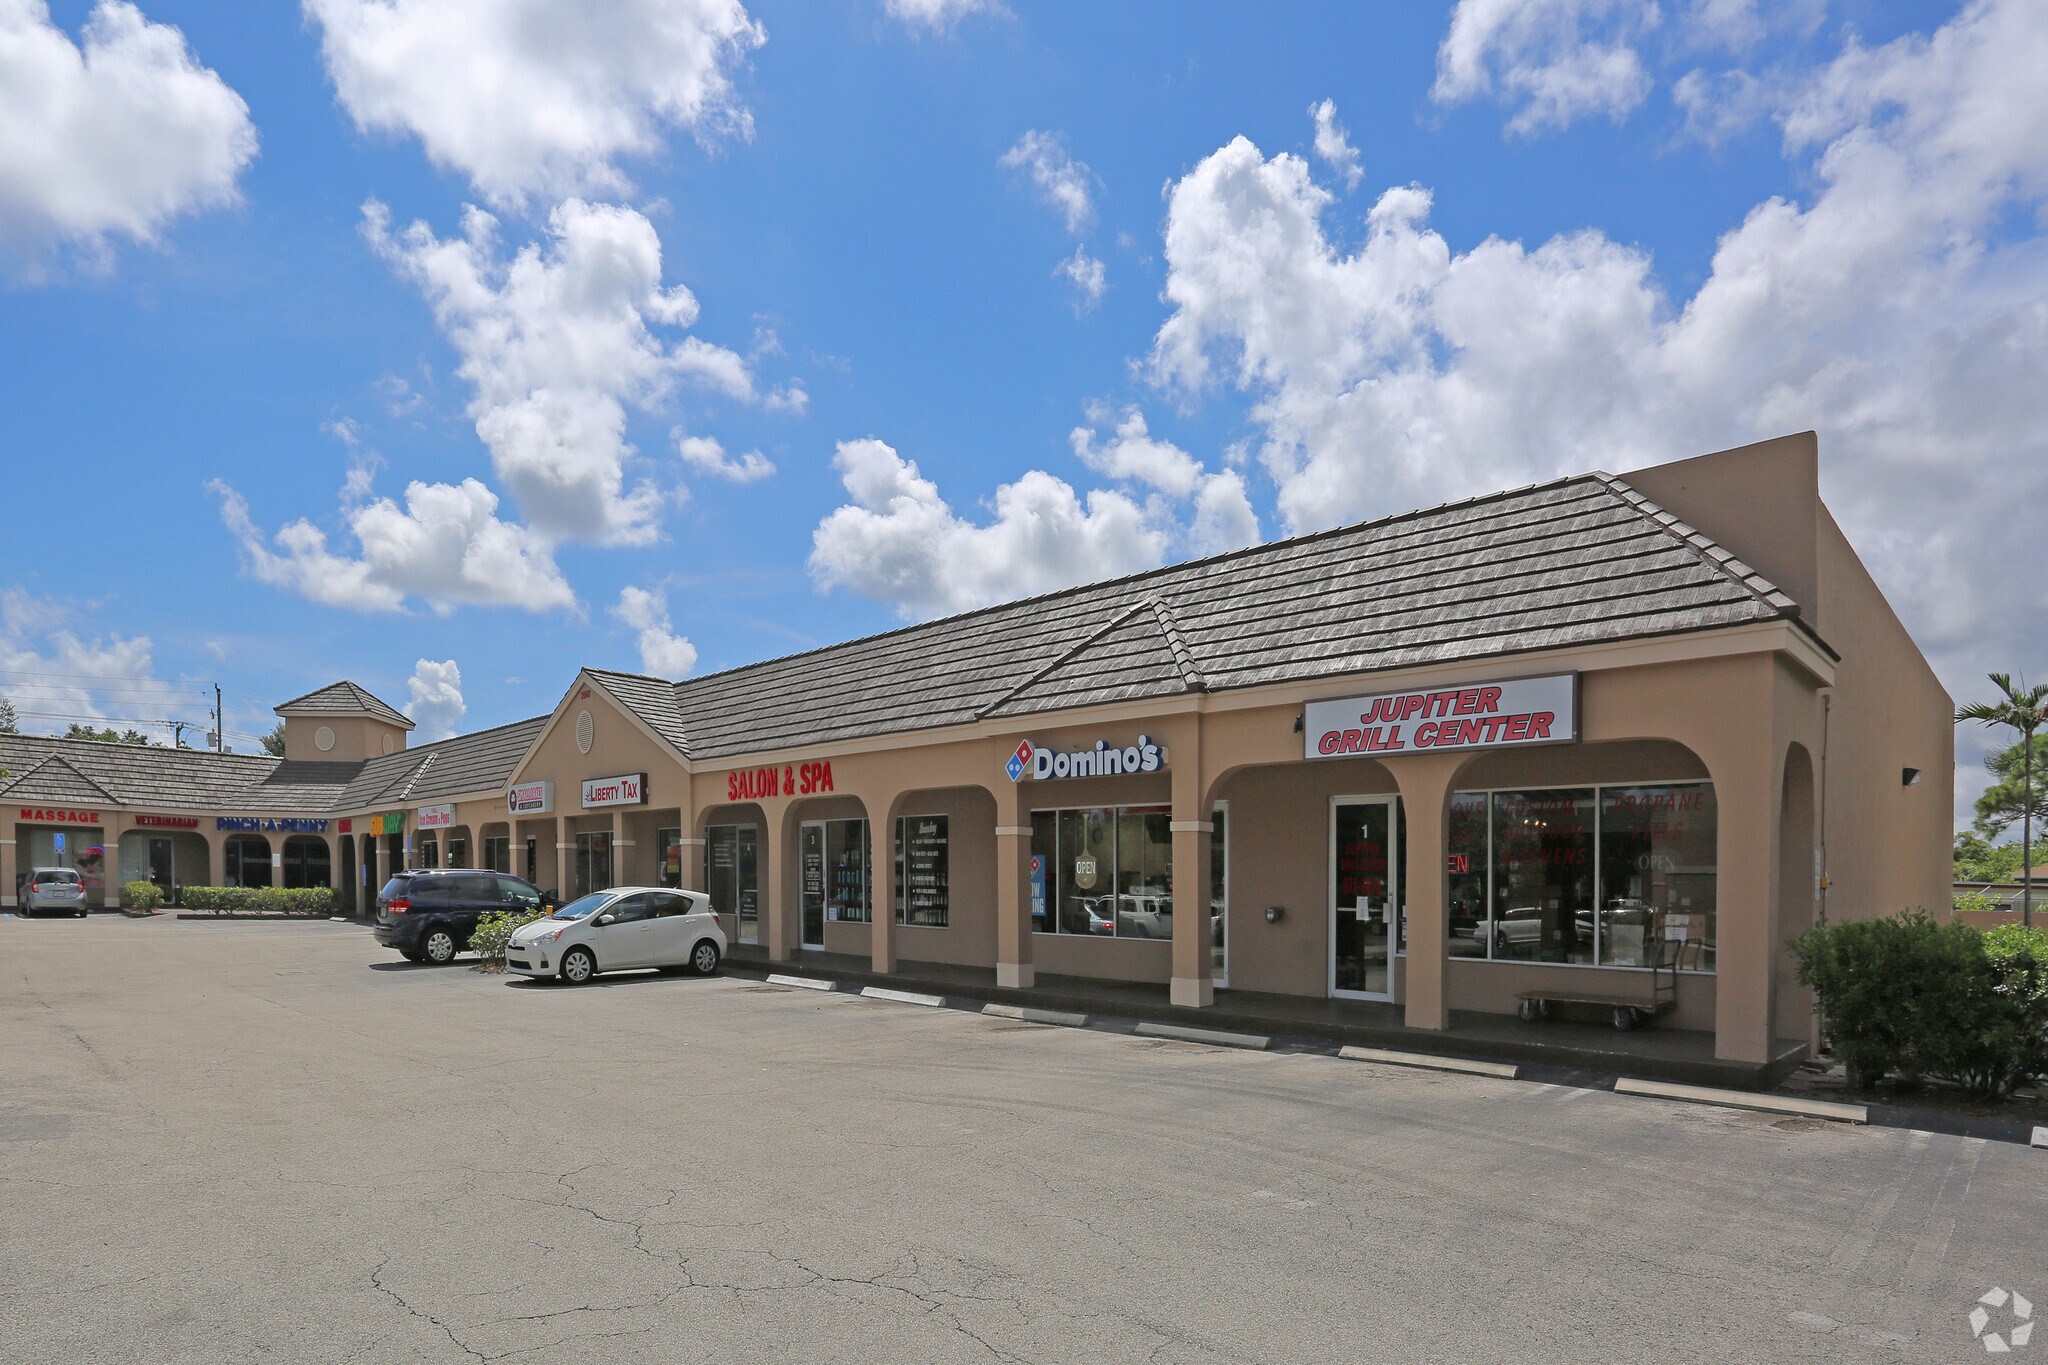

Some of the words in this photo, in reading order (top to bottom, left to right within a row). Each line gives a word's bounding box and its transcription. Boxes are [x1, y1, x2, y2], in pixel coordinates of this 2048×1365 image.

[1360, 686, 1502, 725] JUPITER
[1318, 724, 1406, 757] GRILL
[1413, 711, 1555, 748] CENTER
[1033, 734, 1162, 780] Domino's
[727, 767, 778, 801] SALON
[783, 765, 795, 796] &
[800, 761, 834, 794] SPA
[590, 785, 620, 802] LIBERTY
[621, 780, 638, 799] TAX
[1505, 799, 1576, 818] CUSTOM
[1614, 793, 1705, 814] PROPANE
[20, 808, 100, 823] MASSAGE
[135, 815, 199, 828] VETERINARIAN
[370, 810, 406, 837] SUBWAY
[811, 835, 815, 844] 3
[1361, 823, 1369, 839] 1
[1632, 822, 1686, 841] FILLS
[1447, 854, 1470, 873] EN
[1499, 847, 1589, 865] KITCHENS
[1638, 855, 1677, 871] OPEN
[1076, 861, 1096, 874] OPEN
[1032, 898, 1044, 913] ING
